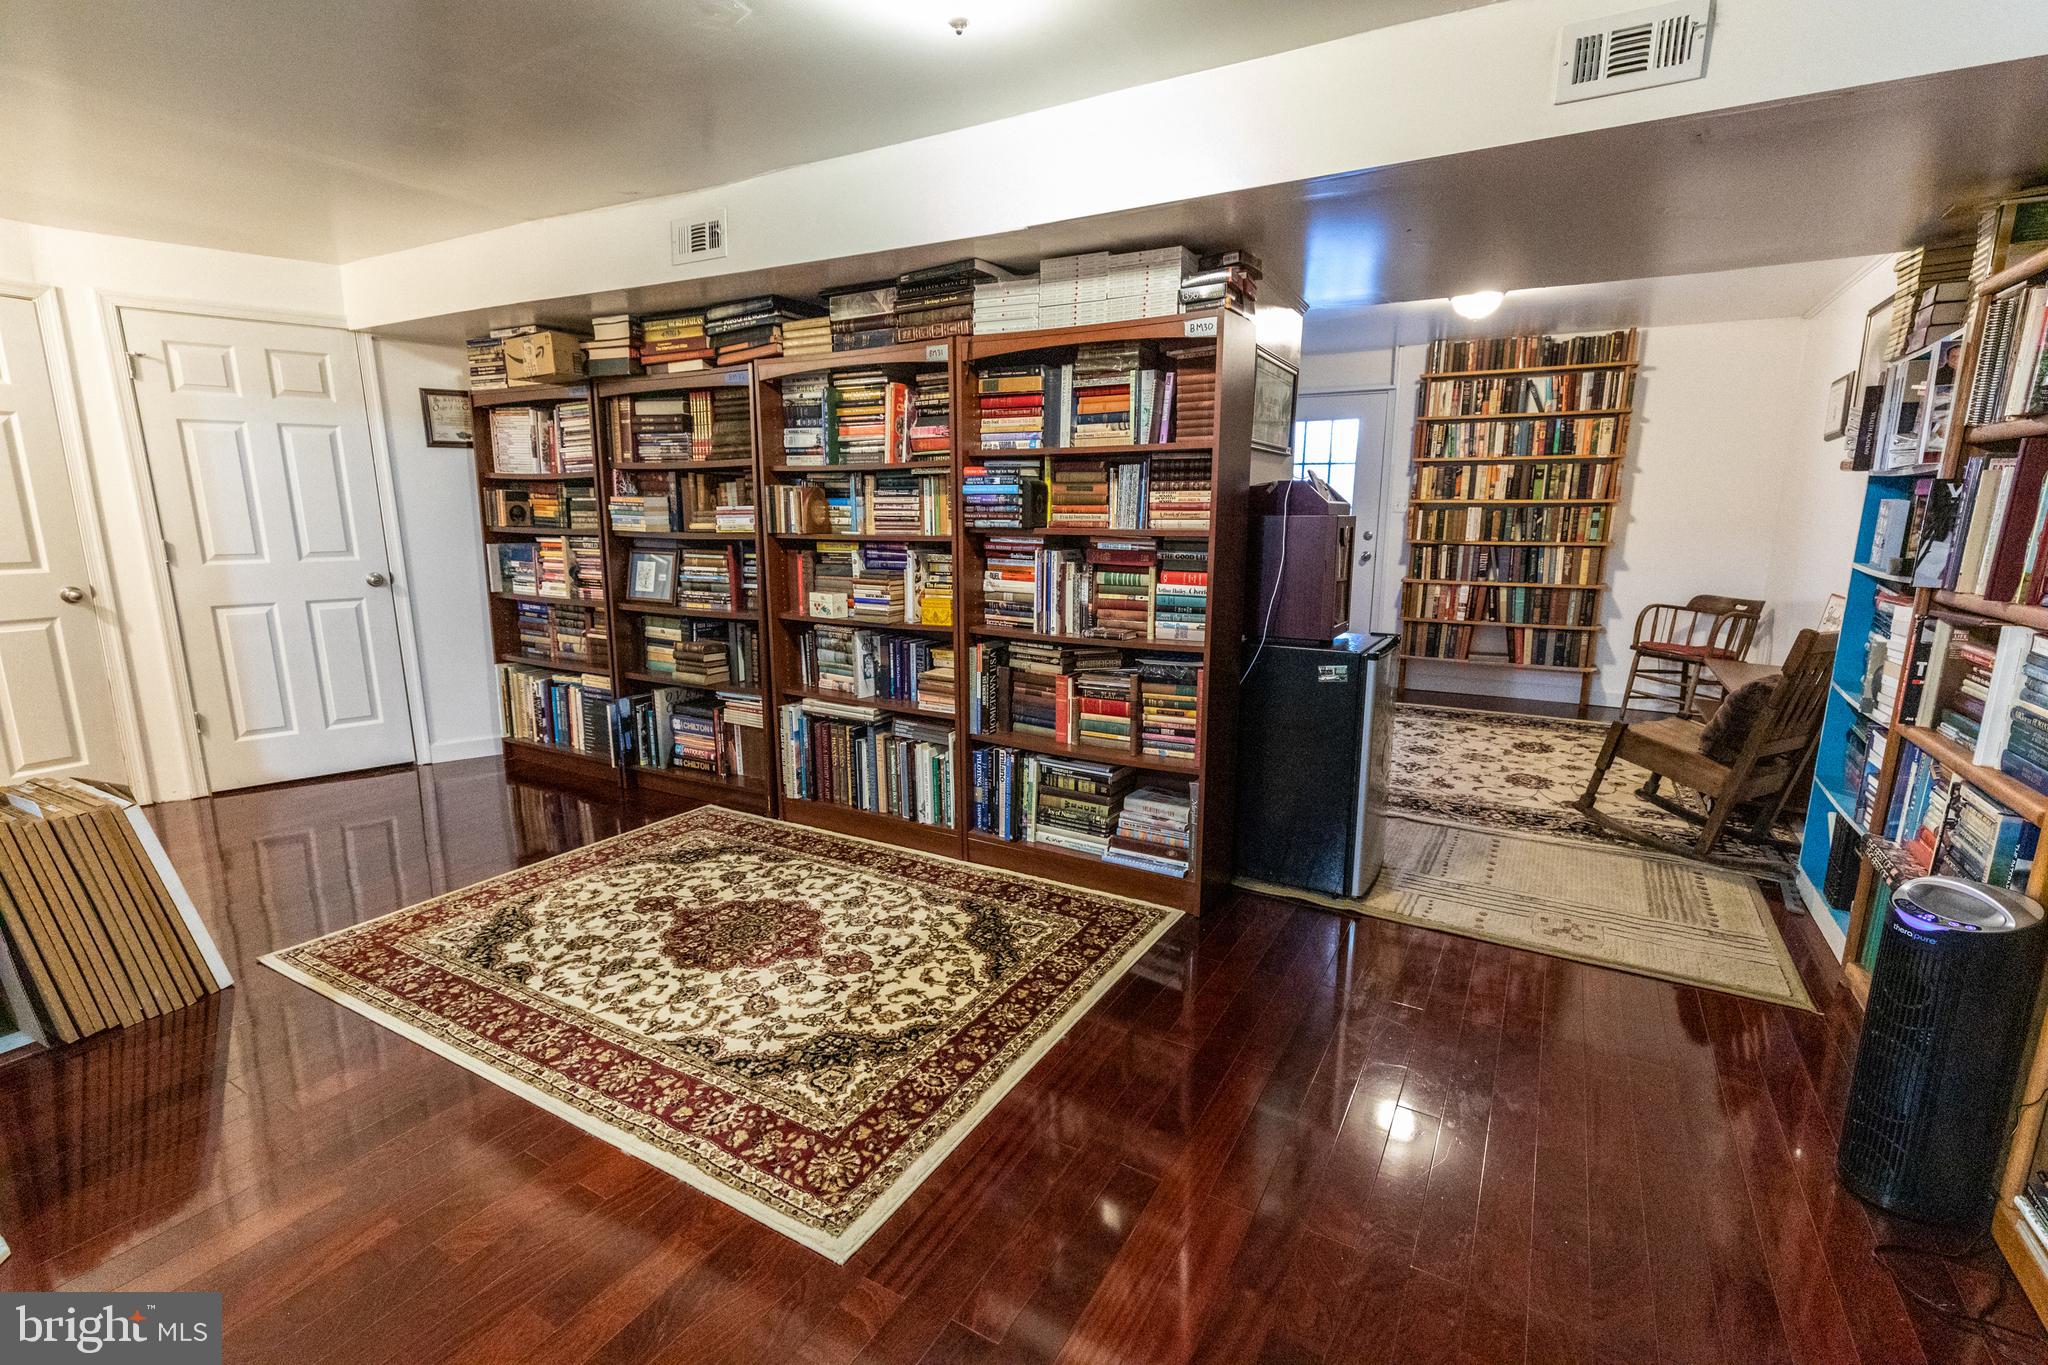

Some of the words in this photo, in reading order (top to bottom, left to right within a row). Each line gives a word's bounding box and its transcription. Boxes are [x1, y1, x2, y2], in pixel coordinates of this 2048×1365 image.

[1189, 323, 1214, 333] BM30
[1868, 411, 1877, 432] WEALTH
[1864, 432, 1873, 455] ACADEMY
[989, 651, 997, 672] USA
[989, 675, 997, 734] HOMETOWN
[683, 722, 710, 732] CHILTON
[683, 746, 705, 758] ANTIQUES
[683, 757, 710, 771] CHILTON
[1047, 808, 1055, 816] Joy
